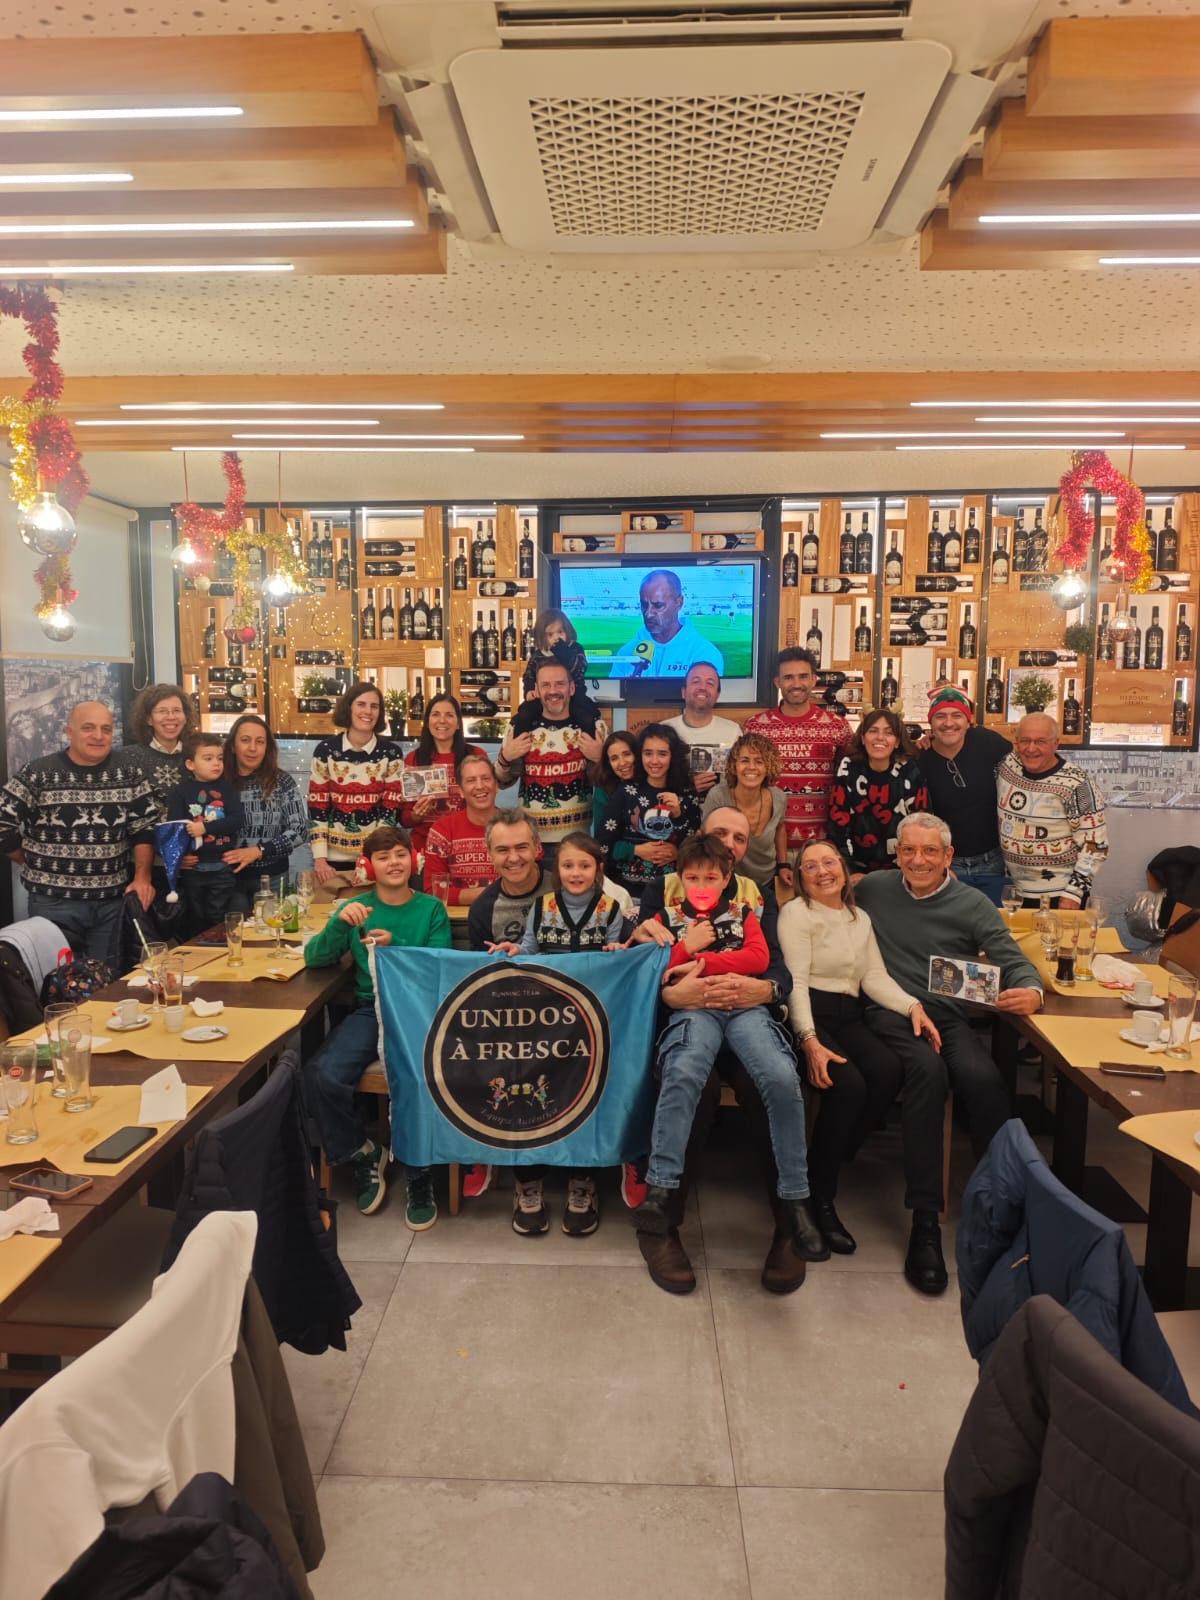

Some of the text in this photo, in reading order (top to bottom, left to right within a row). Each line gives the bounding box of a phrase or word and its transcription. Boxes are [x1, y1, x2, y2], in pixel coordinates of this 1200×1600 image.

[456, 853, 485, 863] SUPER
[459, 1006, 577, 1029] UNIDOS
[449, 1037, 591, 1061] À FRESCA
